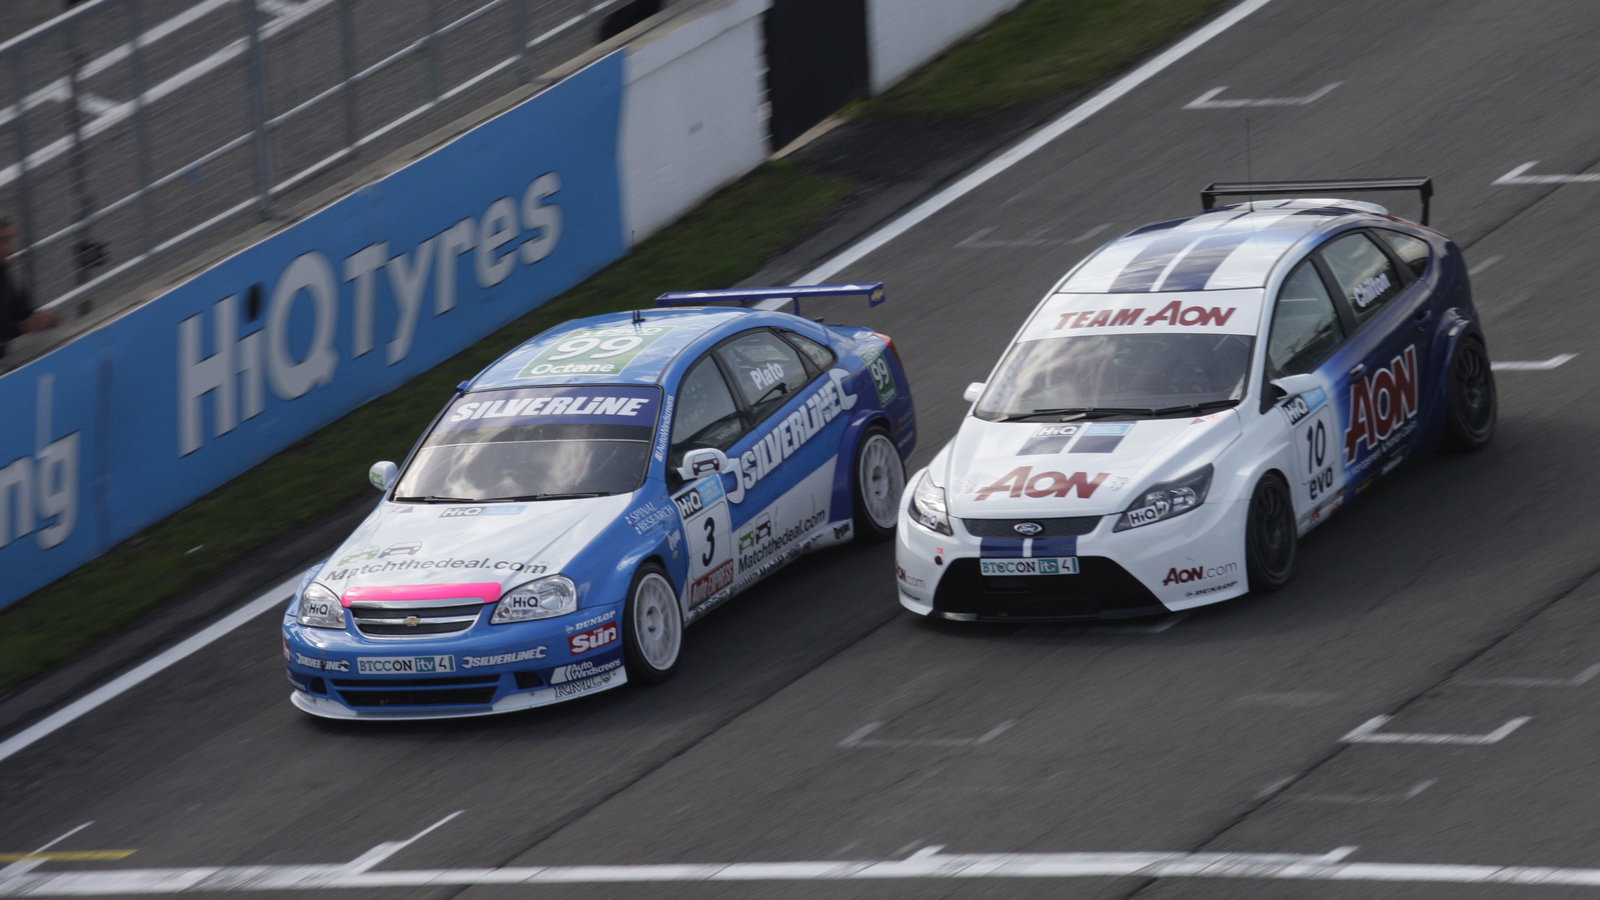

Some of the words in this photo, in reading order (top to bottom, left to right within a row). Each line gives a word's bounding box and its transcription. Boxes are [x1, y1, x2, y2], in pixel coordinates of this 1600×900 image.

[176, 250, 339, 458] HiQ
[344, 171, 563, 367] Tyres
[1053, 307, 1147, 331] TEAM
[548, 335, 643, 362] 99
[530, 362, 614, 375] Octane
[750, 362, 785, 391] Plato
[870, 357, 890, 391] 99
[1038, 424, 1078, 436] HiQ
[1307, 418, 1326, 475] 10
[1309, 466, 1333, 500] evo
[444, 507, 482, 517] HiQ
[629, 501, 659, 522] SPINAL
[677, 491, 703, 518] HiQ
[1130, 508, 1158, 525] HiQ
[638, 504, 676, 534] RESEARCH
[702, 517, 715, 567] 3
[737, 509, 826, 574] Matchthedeal.com
[325, 557, 549, 583] Matchthedeal.com
[308, 603, 329, 615] HiQ
[512, 595, 539, 609] HiQ
[574, 609, 616, 631] DUNLOP
[572, 660, 593, 671] Auto
[572, 659, 621, 680] Windscreens
[553, 677, 602, 699] RML
